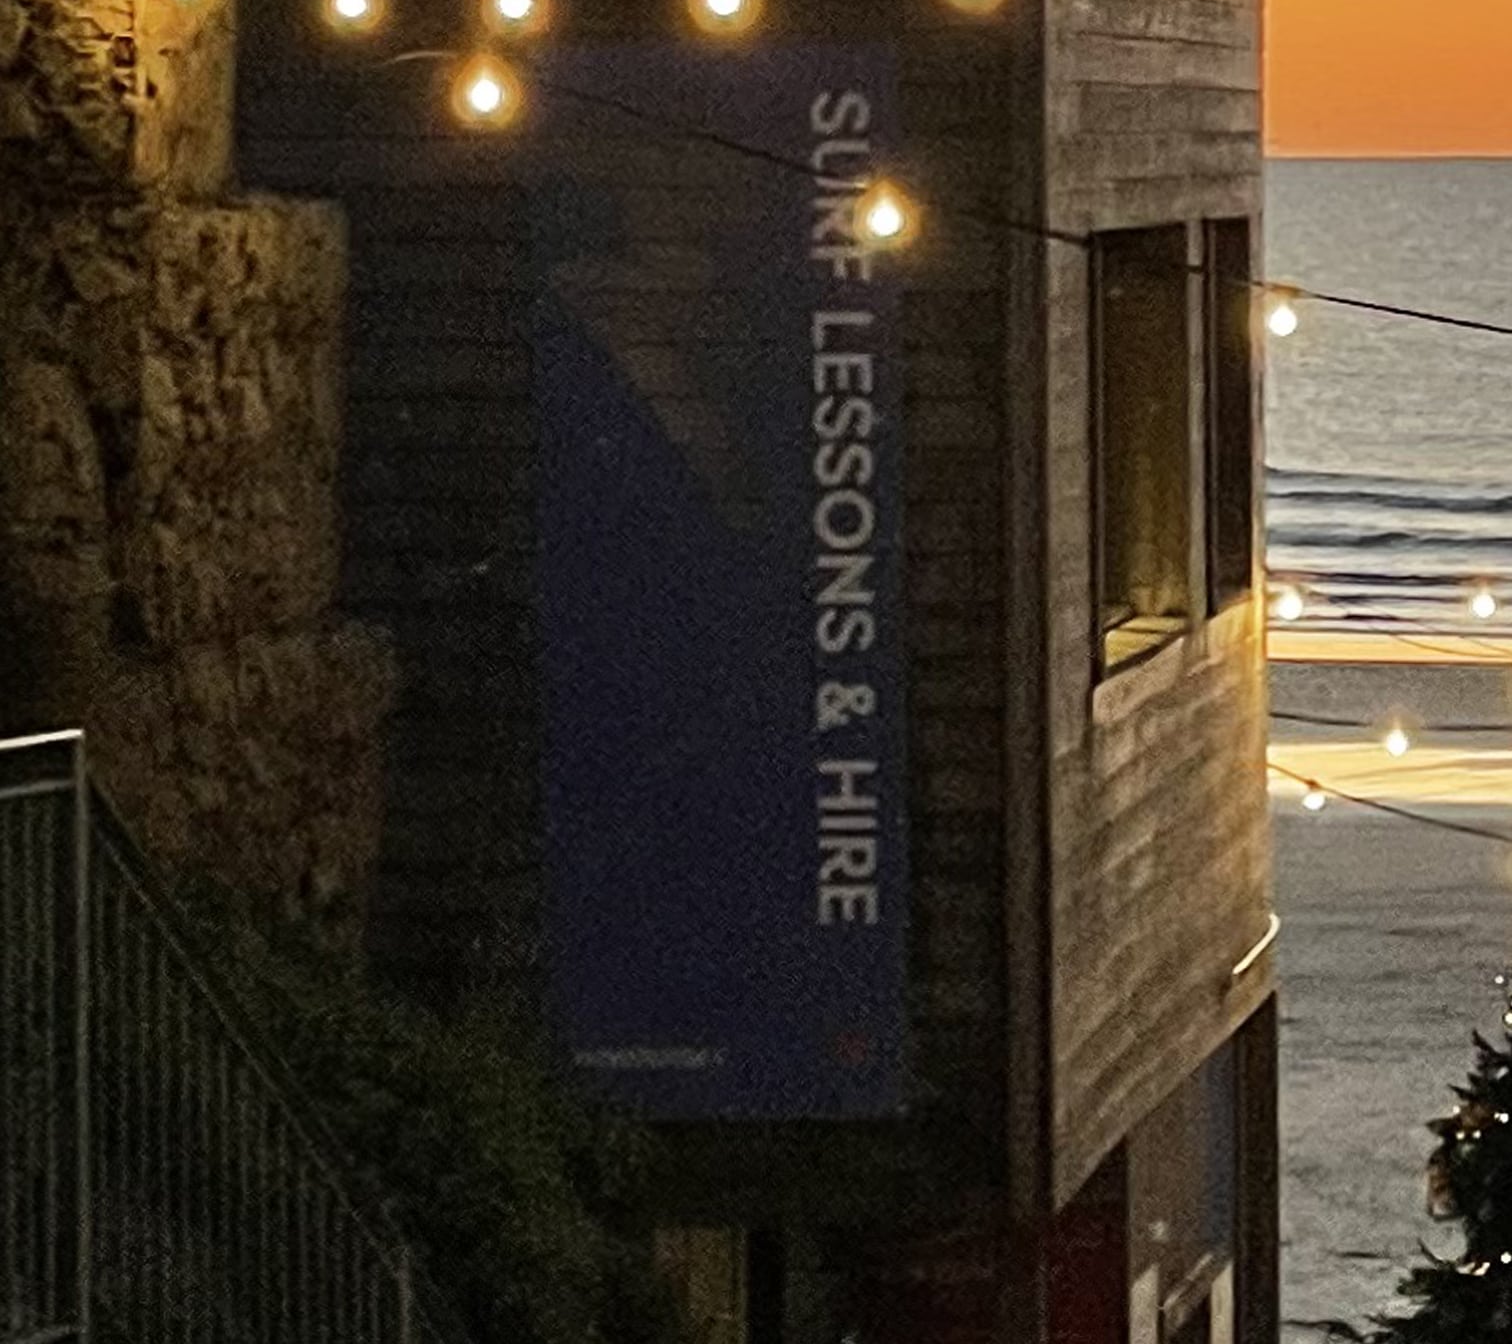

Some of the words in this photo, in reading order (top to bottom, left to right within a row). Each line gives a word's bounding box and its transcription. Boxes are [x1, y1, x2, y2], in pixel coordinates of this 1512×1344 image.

[812, 312, 876, 653] LESSONS
[817, 683, 876, 730] &
[818, 762, 879, 926] HIRE
